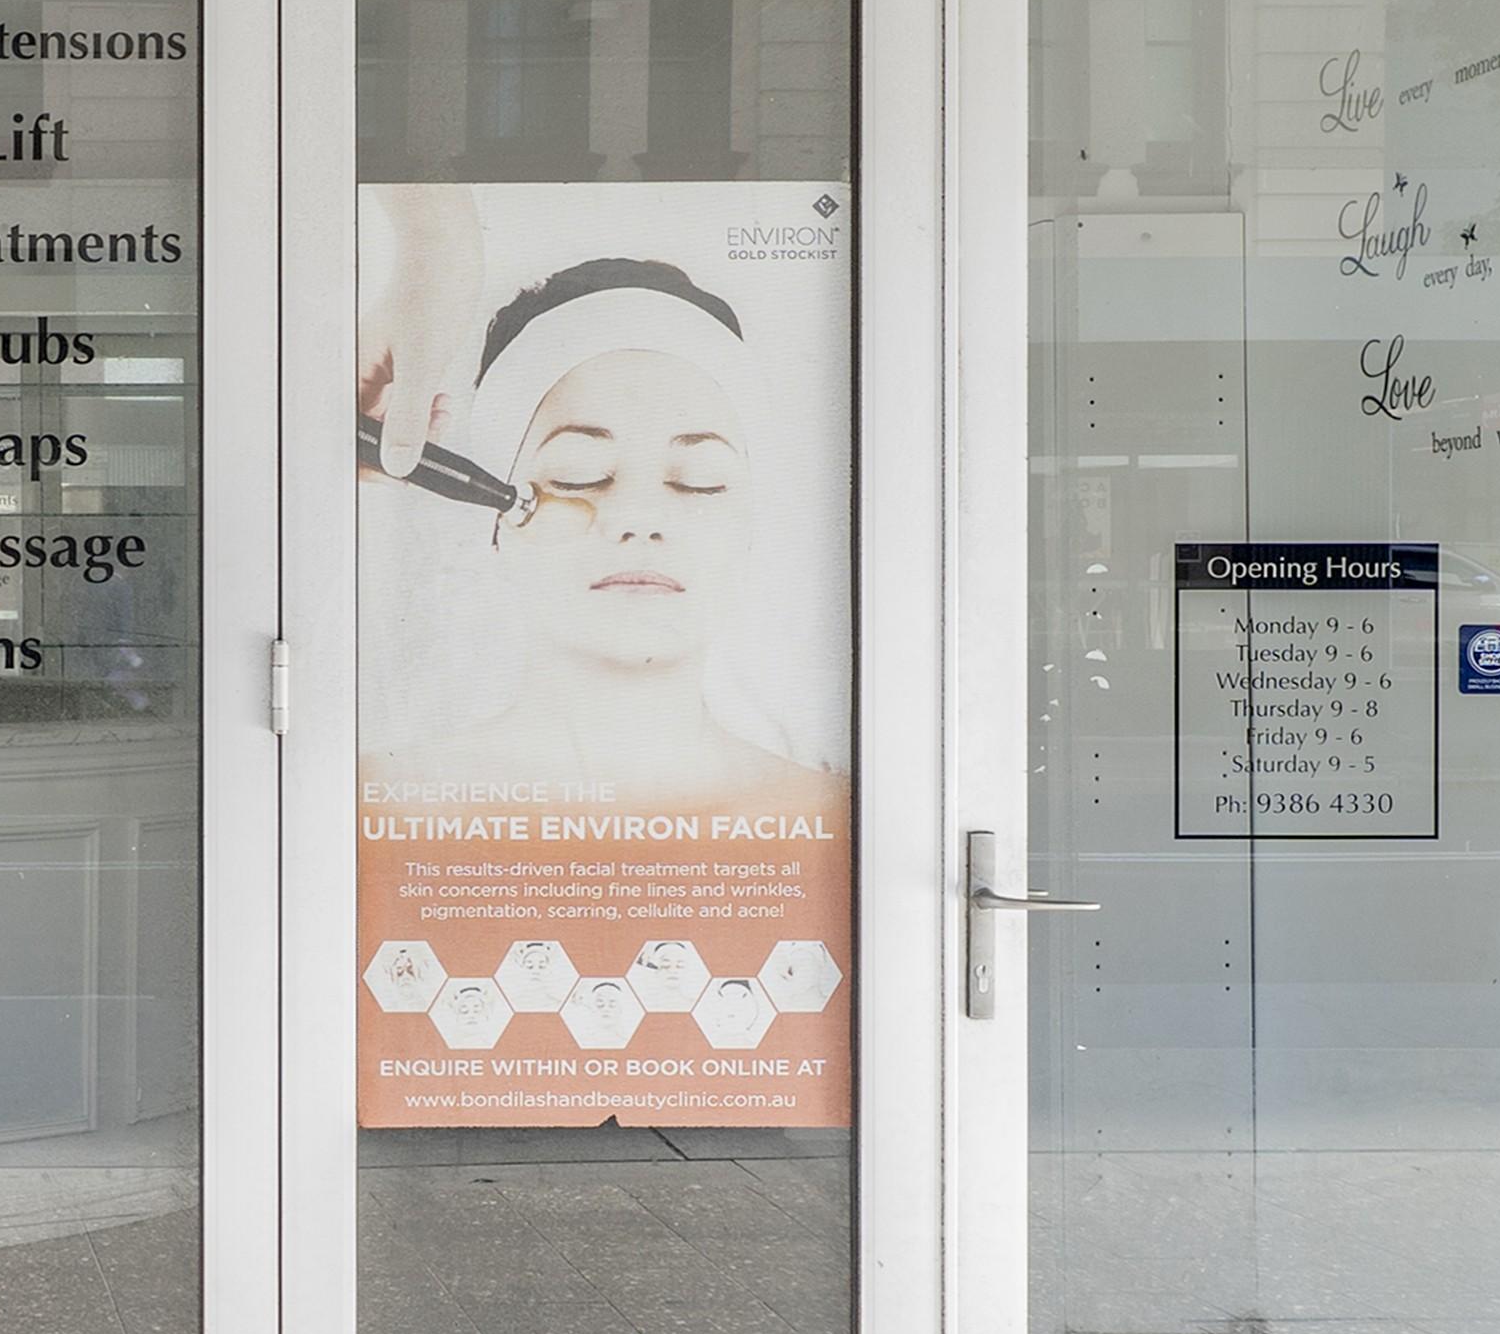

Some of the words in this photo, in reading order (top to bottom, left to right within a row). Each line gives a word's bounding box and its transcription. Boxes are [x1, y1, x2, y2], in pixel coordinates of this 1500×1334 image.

[1320, 49, 1385, 133] Live
[1398, 79, 1433, 106] every
[727, 227, 835, 246] ENVIRON
[1339, 183, 1431, 280] Laugh
[728, 250, 767, 260] GOLD
[771, 250, 838, 260] STOCKIST
[1423, 263, 1457, 289] every
[1465, 254, 1493, 279] day,
[1361, 335, 1436, 420] Love
[1432, 425, 1482, 459] beyond
[1207, 556, 1318, 585] Opening
[1326, 556, 1402, 579] Hours
[1234, 617, 1319, 639] Monday
[1326, 618, 1339, 634] 9
[1361, 617, 1374, 634] 6
[1236, 645, 1318, 667] Tuesday
[1325, 646, 1338, 662] 9
[1360, 645, 1373, 662] 6
[1216, 673, 1337, 694] Wednesday
[1344, 674, 1357, 689] 9
[1379, 673, 1392, 689] 6
[1230, 700, 1323, 722] Thursday
[1331, 702, 1343, 717] 9
[1366, 701, 1378, 717] 8
[1246, 728, 1308, 750] Friday
[1315, 729, 1328, 745] 9
[1351, 728, 1363, 745] 6
[1232, 756, 1320, 777] Saturday
[1328, 757, 1341, 773] 9
[1364, 757, 1375, 773] 5
[363, 782, 549, 803] EXPERIENCE
[560, 782, 616, 803] THE
[1215, 796, 1247, 814] Ph:
[1257, 793, 1320, 815] 9386
[1329, 793, 1394, 815] 4330
[363, 816, 529, 841] ULTIMATE
[541, 816, 699, 840] ENVIRON
[711, 816, 834, 840] FACIAL
[405, 862, 441, 876] This
[446, 862, 564, 876] results-driven
[569, 862, 615, 876] facial
[621, 862, 707, 876] treatment
[713, 862, 776, 878] targets
[781, 862, 801, 876] all
[399, 883, 433, 897] skin
[439, 884, 518, 897] concerns
[523, 883, 603, 900] including
[609, 882, 642, 897] fine
[647, 882, 686, 897] lines
[691, 882, 725, 897] and
[731, 882, 806, 899] wrinkles,
[421, 903, 542, 920] pigmentation,
[548, 903, 622, 920] scarring,
[627, 903, 693, 918] cellulite
[699, 903, 732, 918] and
[737, 903, 784, 918] acne!
[380, 1059, 484, 1077] ENQUIRE
[491, 1059, 577, 1077] WITHIN
[584, 1059, 618, 1077] OR
[626, 1059, 695, 1077] BOOK
[702, 1059, 790, 1077] ONLINE
[797, 1059, 827, 1077] AT
[404, 1091, 797, 1109] www.bondilashandbeautyclinic.com.au
